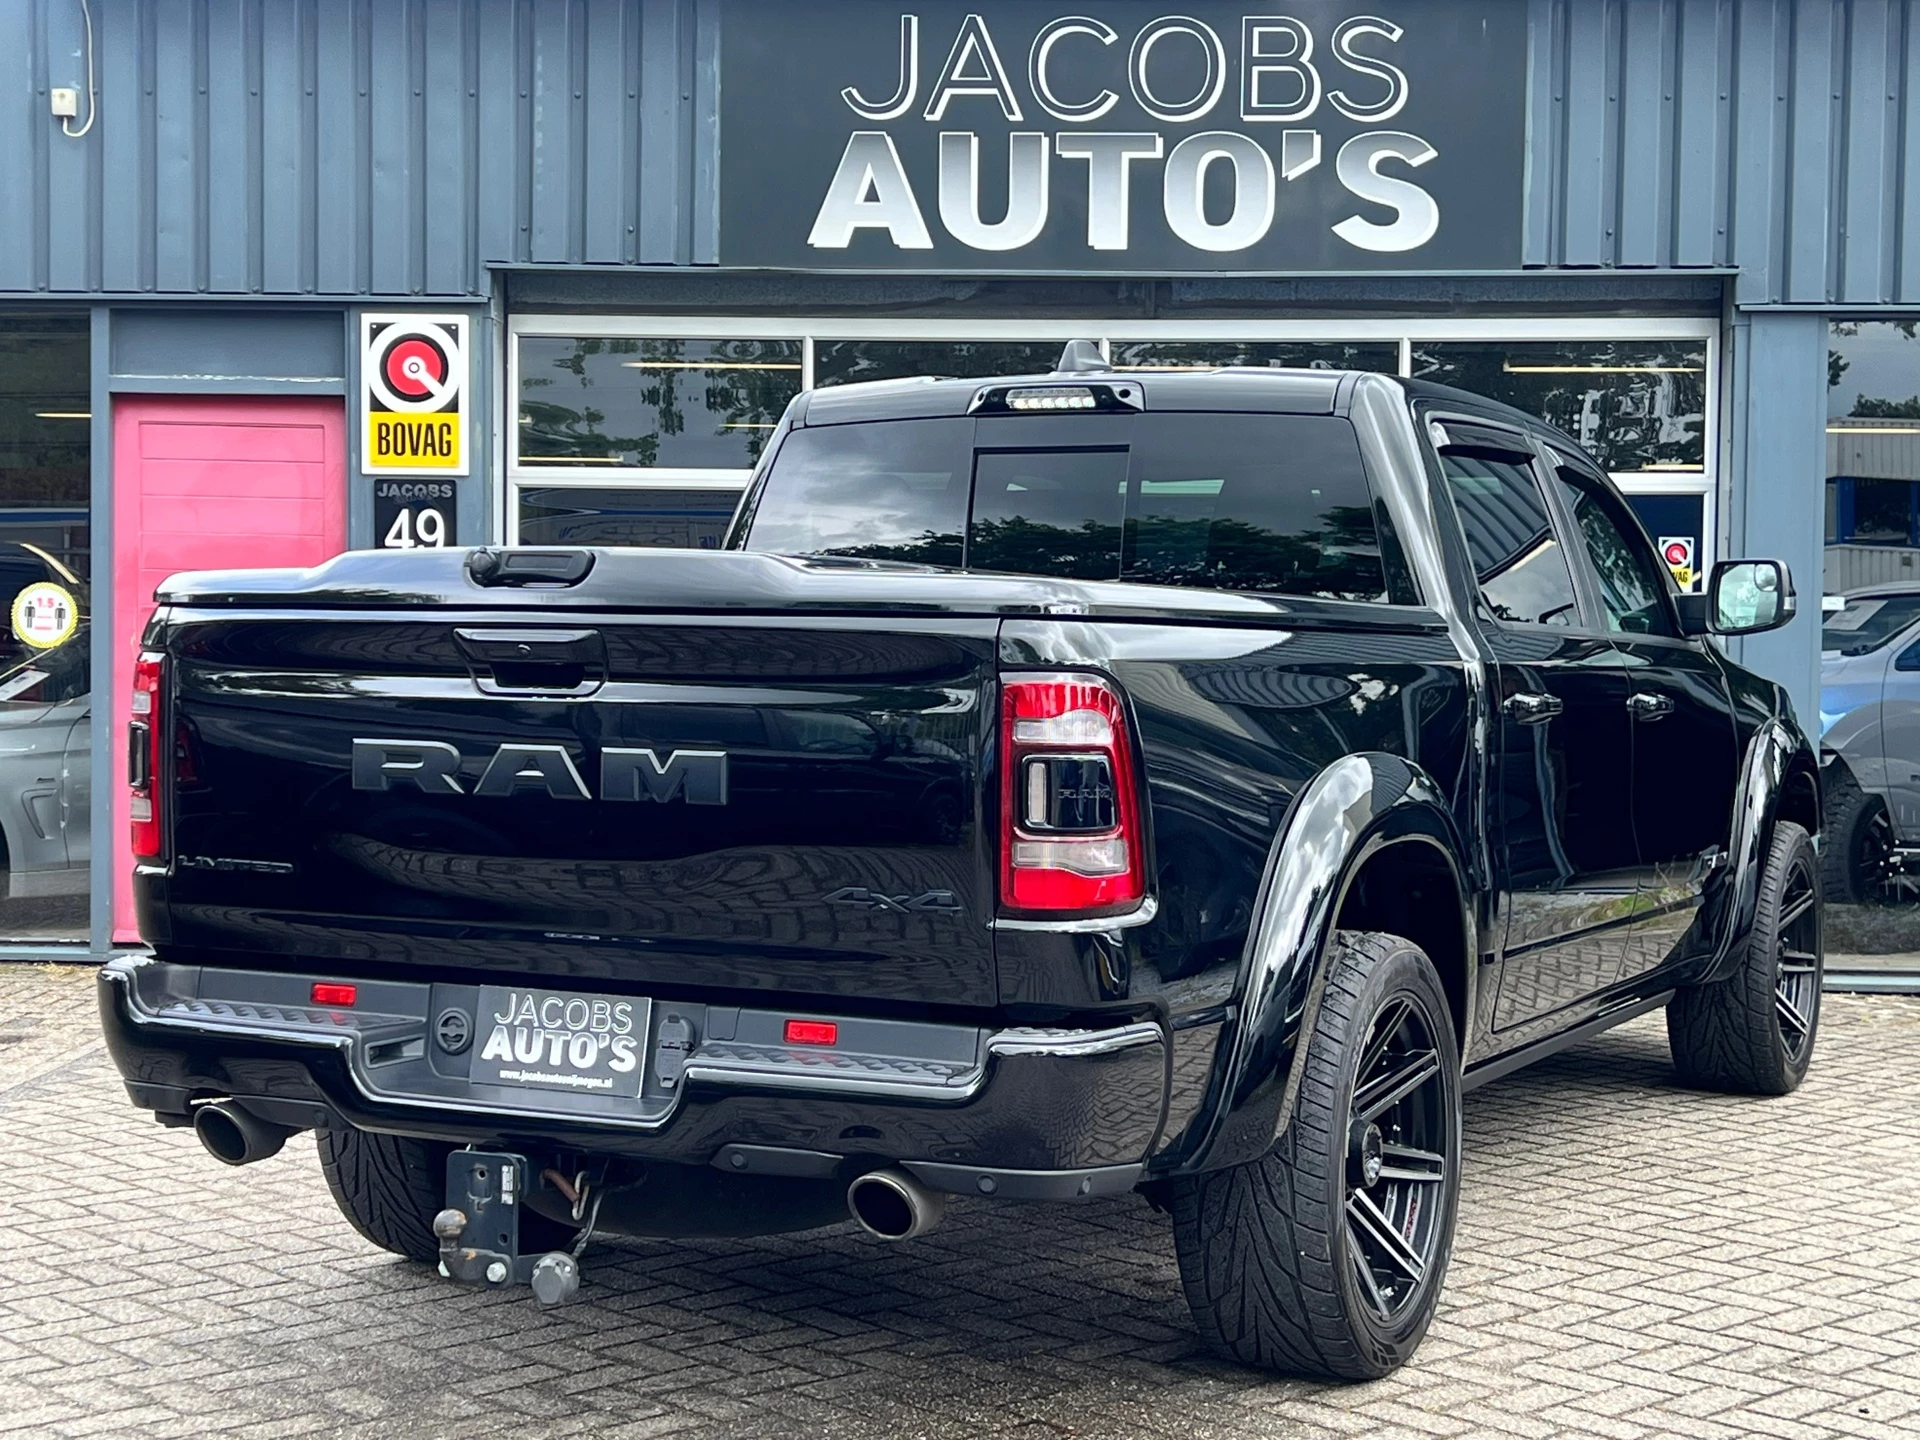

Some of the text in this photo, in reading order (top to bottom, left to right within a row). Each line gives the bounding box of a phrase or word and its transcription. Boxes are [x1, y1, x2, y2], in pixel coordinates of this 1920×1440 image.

[841, 14, 1408, 121] JACOBS
[806, 131, 1439, 251] AUTO'S
[377, 422, 452, 456] BOVAG
[377, 484, 453, 498] JACOBS
[384, 508, 445, 549] 49
[352, 738, 727, 806] RAM
[493, 993, 633, 1034] JACOBS
[480, 1025, 638, 1072] AUTO'S
